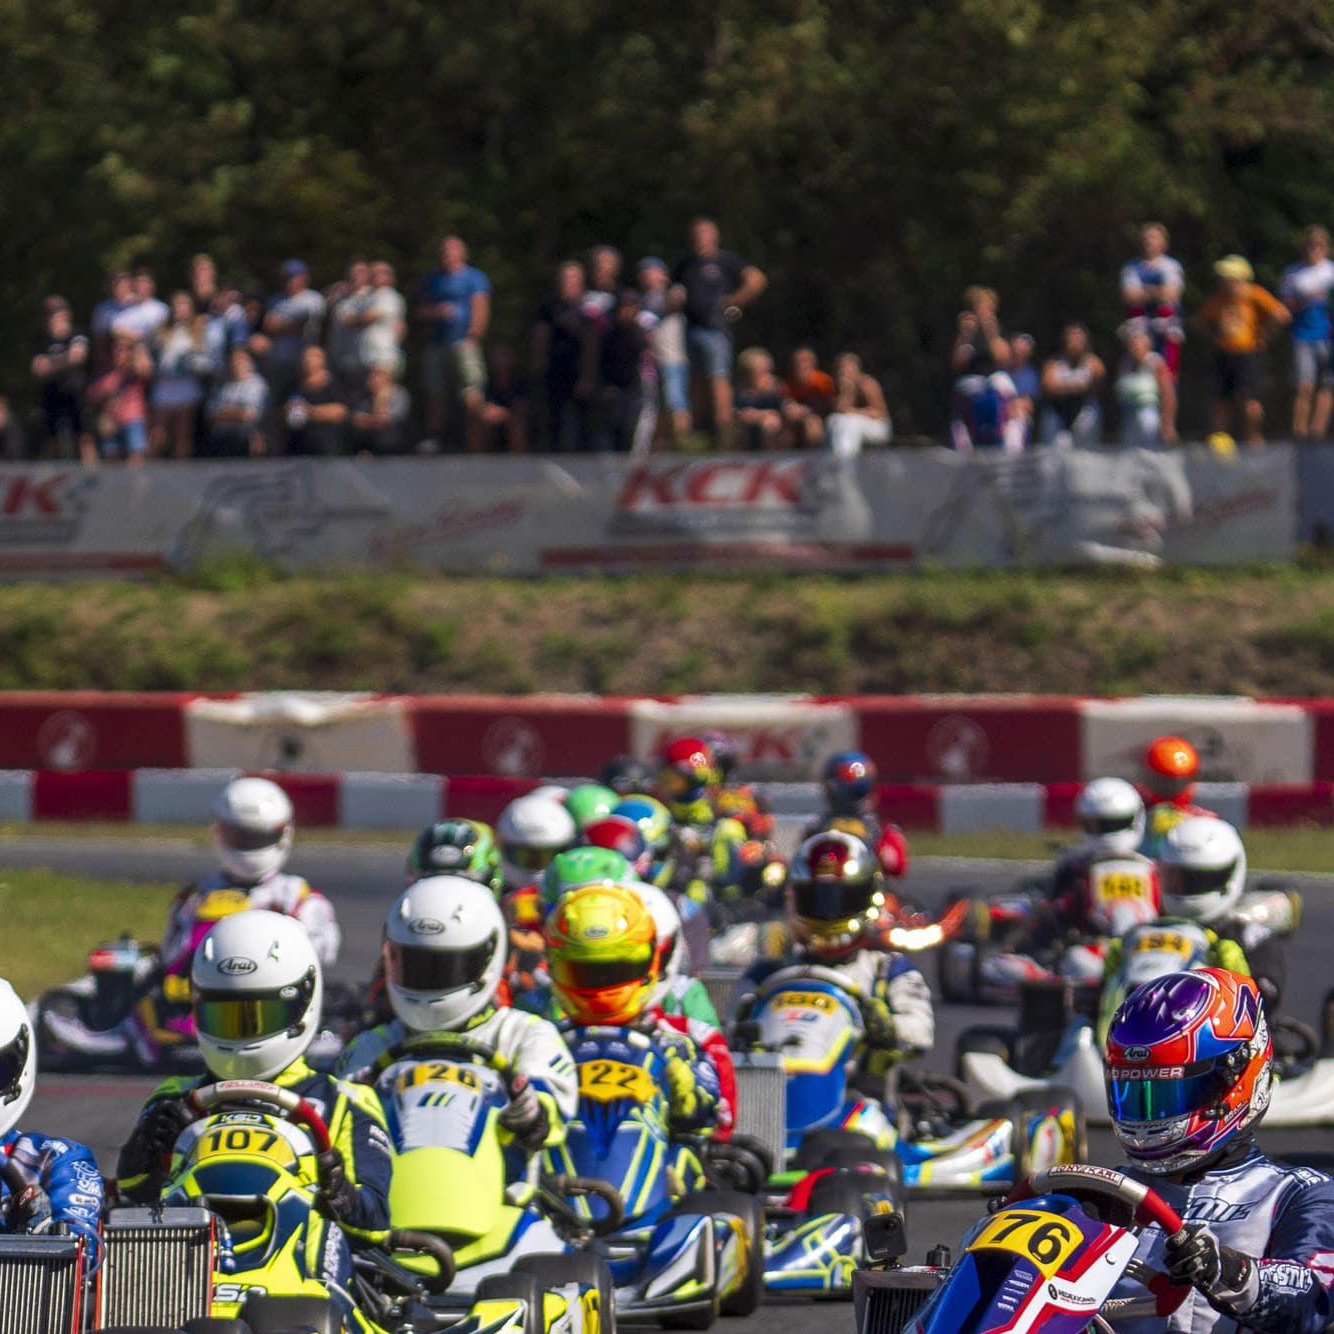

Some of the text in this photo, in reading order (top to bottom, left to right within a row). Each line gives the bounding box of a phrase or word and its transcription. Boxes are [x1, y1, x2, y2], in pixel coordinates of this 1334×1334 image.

[619, 460, 807, 508] KCK
[402, 1063, 477, 1088] 126
[577, 1062, 639, 1091] 22
[1120, 1066, 1185, 1080] POWER
[207, 1129, 278, 1151] 107
[213, 1284, 267, 1302] SD
